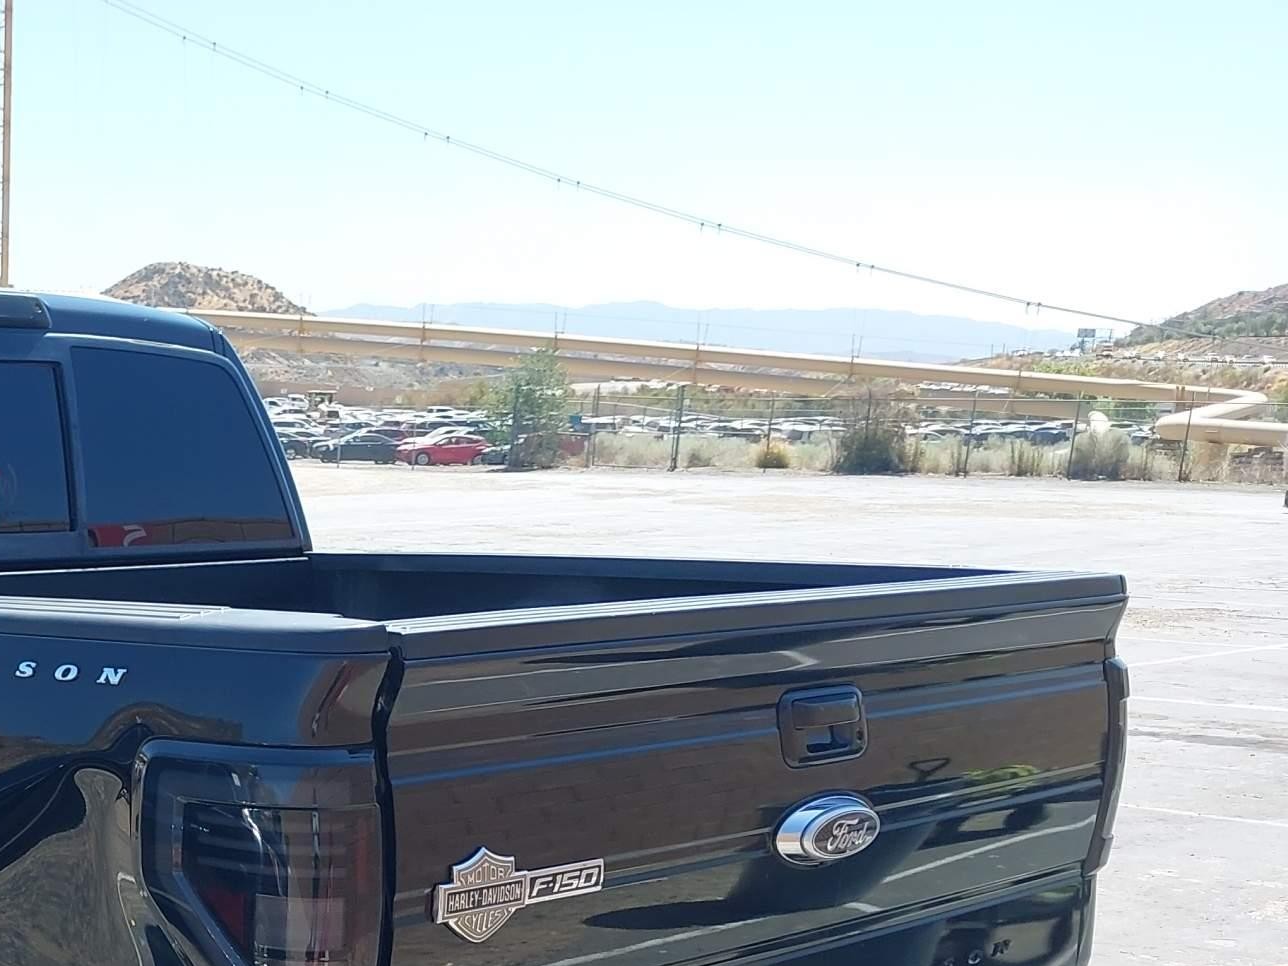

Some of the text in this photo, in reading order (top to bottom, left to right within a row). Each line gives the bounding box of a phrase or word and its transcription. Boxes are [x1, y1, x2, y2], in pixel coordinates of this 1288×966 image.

[827, 818, 872, 851] Ford
[467, 864, 505, 886] MOTOR
[448, 883, 521, 913] HARLEY-DAVIDSON
[464, 909, 504, 933] CYCLES
